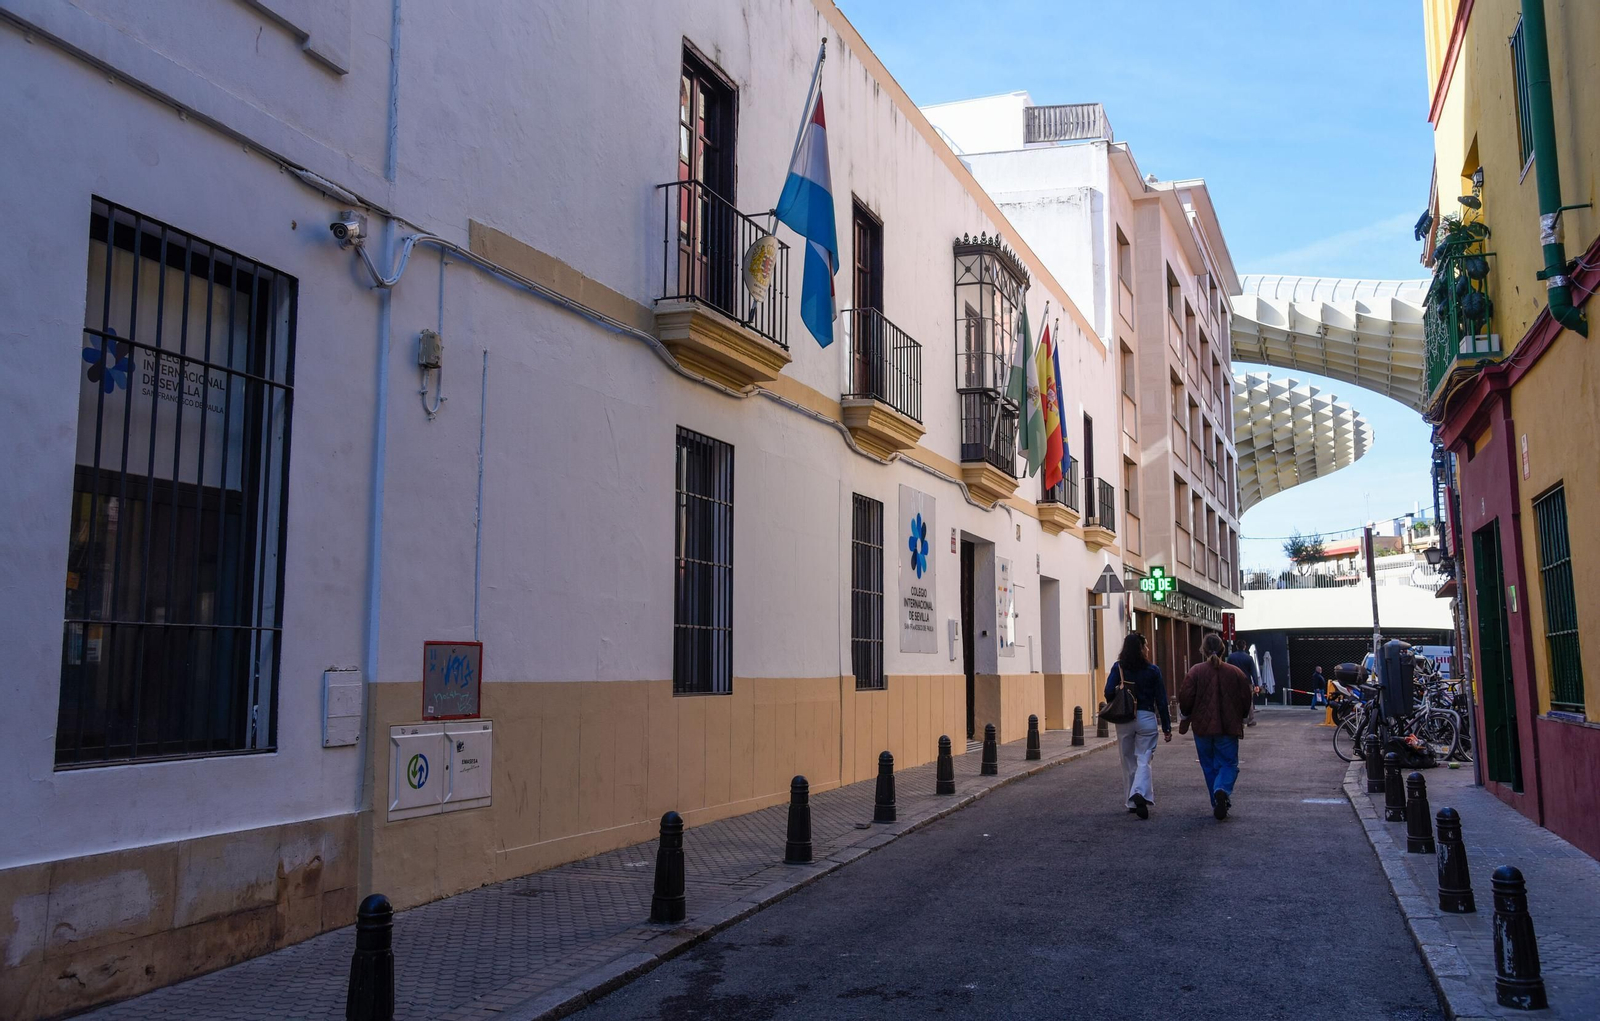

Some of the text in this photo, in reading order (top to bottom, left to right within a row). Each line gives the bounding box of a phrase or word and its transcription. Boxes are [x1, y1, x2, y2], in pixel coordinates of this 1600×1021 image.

[145, 348, 190, 367] CLEG
[143, 359, 225, 391] INERNACIONAL
[142, 373, 200, 398] DE SEVLA
[158, 392, 194, 407] FRANCSCO
[195, 400, 204, 409] DE
[205, 403, 224, 414] AULA
[911, 586, 927, 598] COLEGIO
[1158, 578, 1172, 591] DE
[903, 597, 934, 611] INTERNACIONAL
[908, 610, 930, 622] DE SEVILLA
